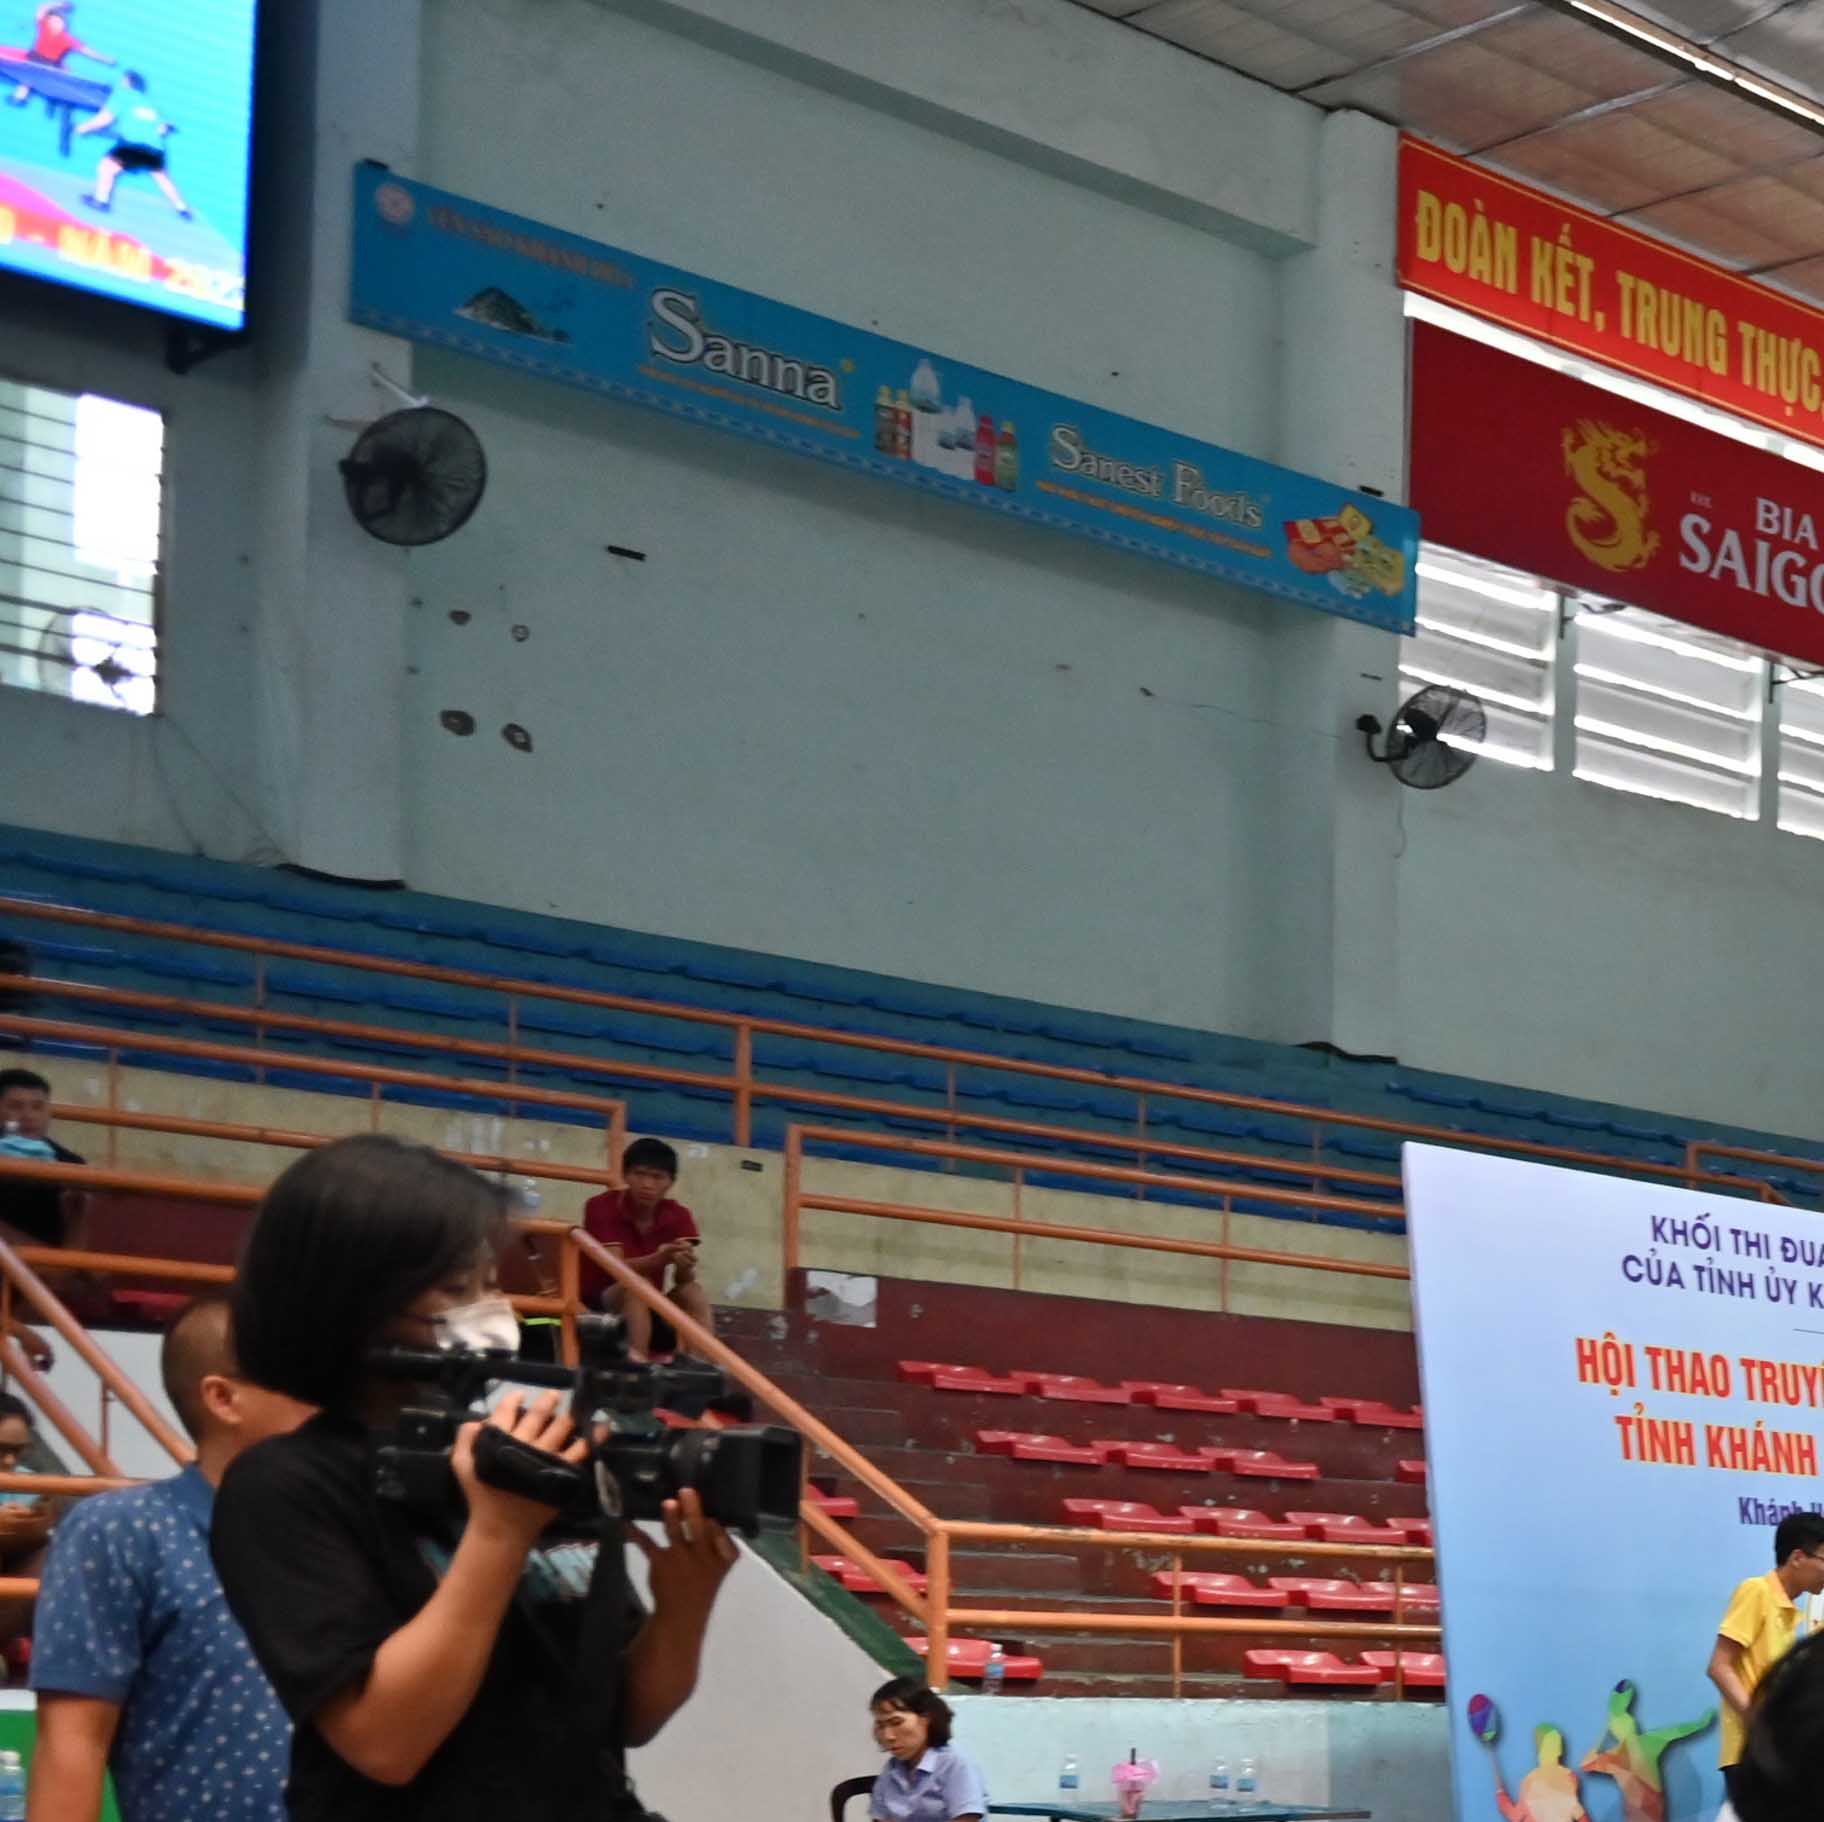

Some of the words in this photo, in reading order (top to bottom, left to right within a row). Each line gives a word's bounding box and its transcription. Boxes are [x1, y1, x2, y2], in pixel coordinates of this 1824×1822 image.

[1415, 189, 1518, 295] ĐOÀN
[1531, 223, 1605, 332] KẾT,
[1615, 270, 1729, 377] TRUNG
[650, 287, 841, 411] Sanna
[1048, 421, 1165, 499] Sanest
[1173, 458, 1265, 531] Foods
[1756, 496, 1820, 551] BIA
[1652, 1211, 1722, 1255] KHỐI
[1731, 1229, 1771, 1260] THI
[1621, 1248, 1684, 1290] CỦA
[1693, 1258, 1755, 1300] TỈNH
[1765, 1267, 1798, 1307] ỦY
[1576, 1332, 1636, 1397] HỘI
[1644, 1345, 1730, 1398] THAO
[1615, 1402, 1696, 1466] TỈNH
[1706, 1412, 1817, 1477] KHÁNH
